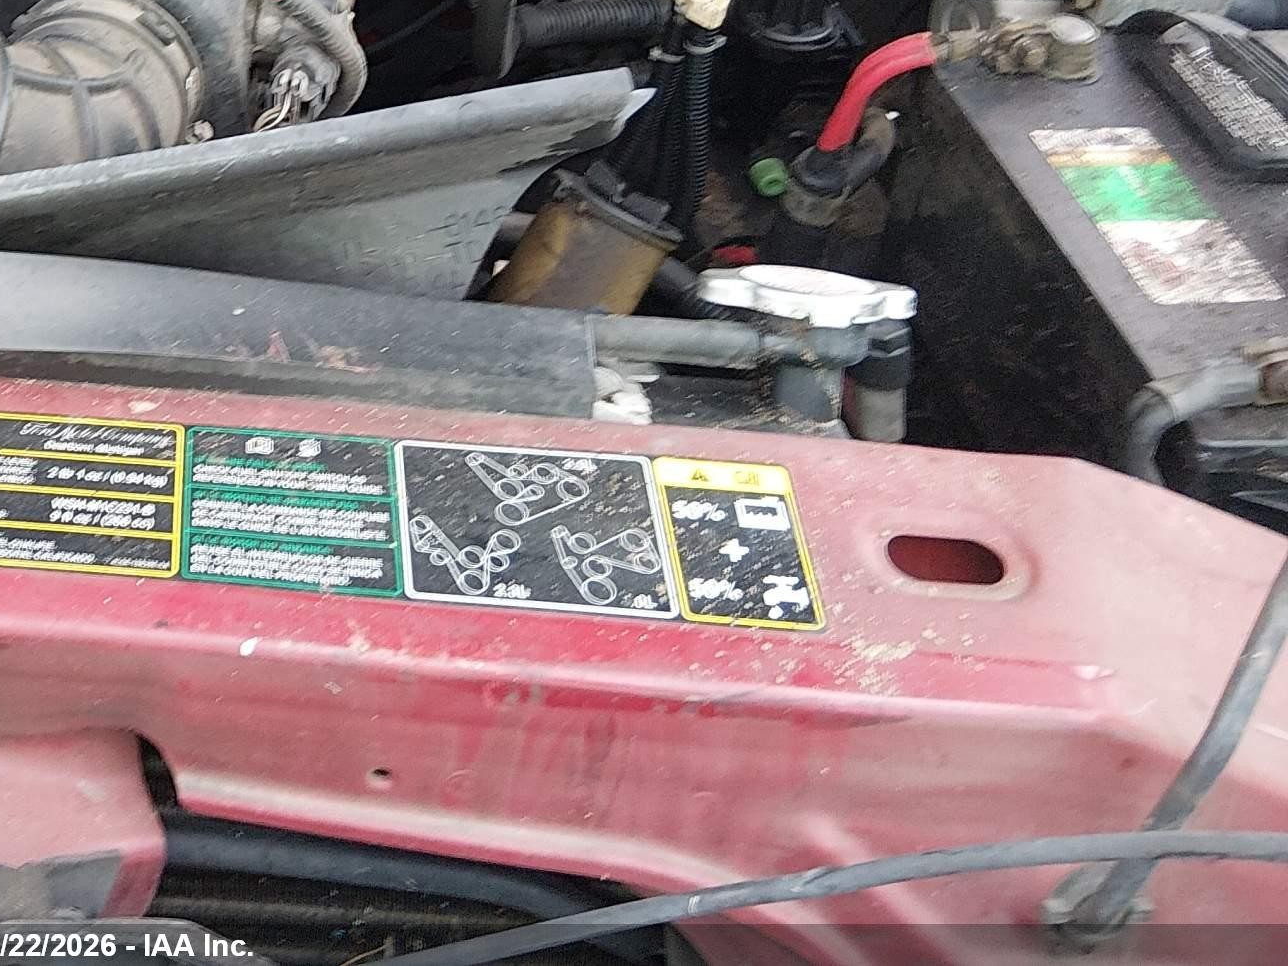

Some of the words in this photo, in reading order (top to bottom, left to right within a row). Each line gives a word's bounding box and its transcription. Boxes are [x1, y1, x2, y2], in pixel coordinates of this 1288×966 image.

[46, 467, 59, 478] 2
[49, 511, 61, 522] 9
[672, 500, 727, 522] 50%
[688, 577, 745, 601] 50%
